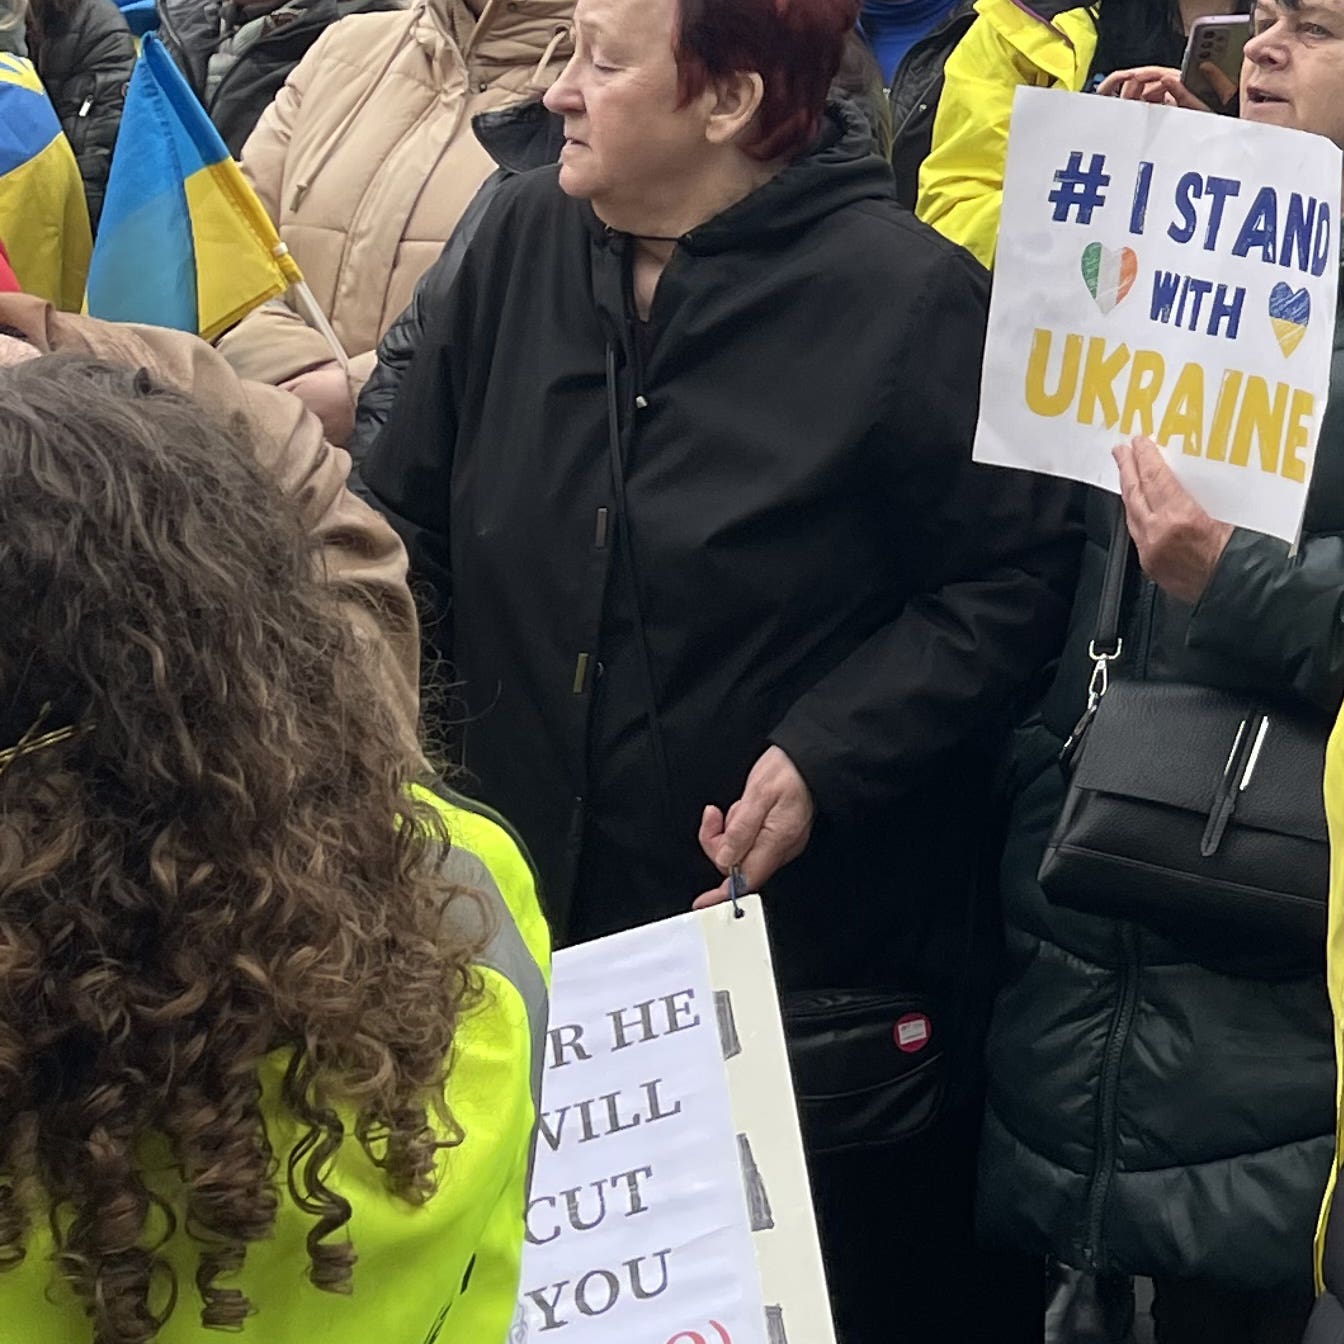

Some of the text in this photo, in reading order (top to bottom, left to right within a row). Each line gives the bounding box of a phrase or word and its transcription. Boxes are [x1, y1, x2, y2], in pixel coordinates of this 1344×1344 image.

[1129, 161, 1153, 235] I
[1167, 171, 1330, 278] STAND
[1150, 270, 1246, 339] WITH
[1024, 328, 1314, 483] UKRAINE
[606, 987, 700, 1053] HE
[524, 1165, 652, 1245] CUT
[524, 1248, 672, 1331] YOU
